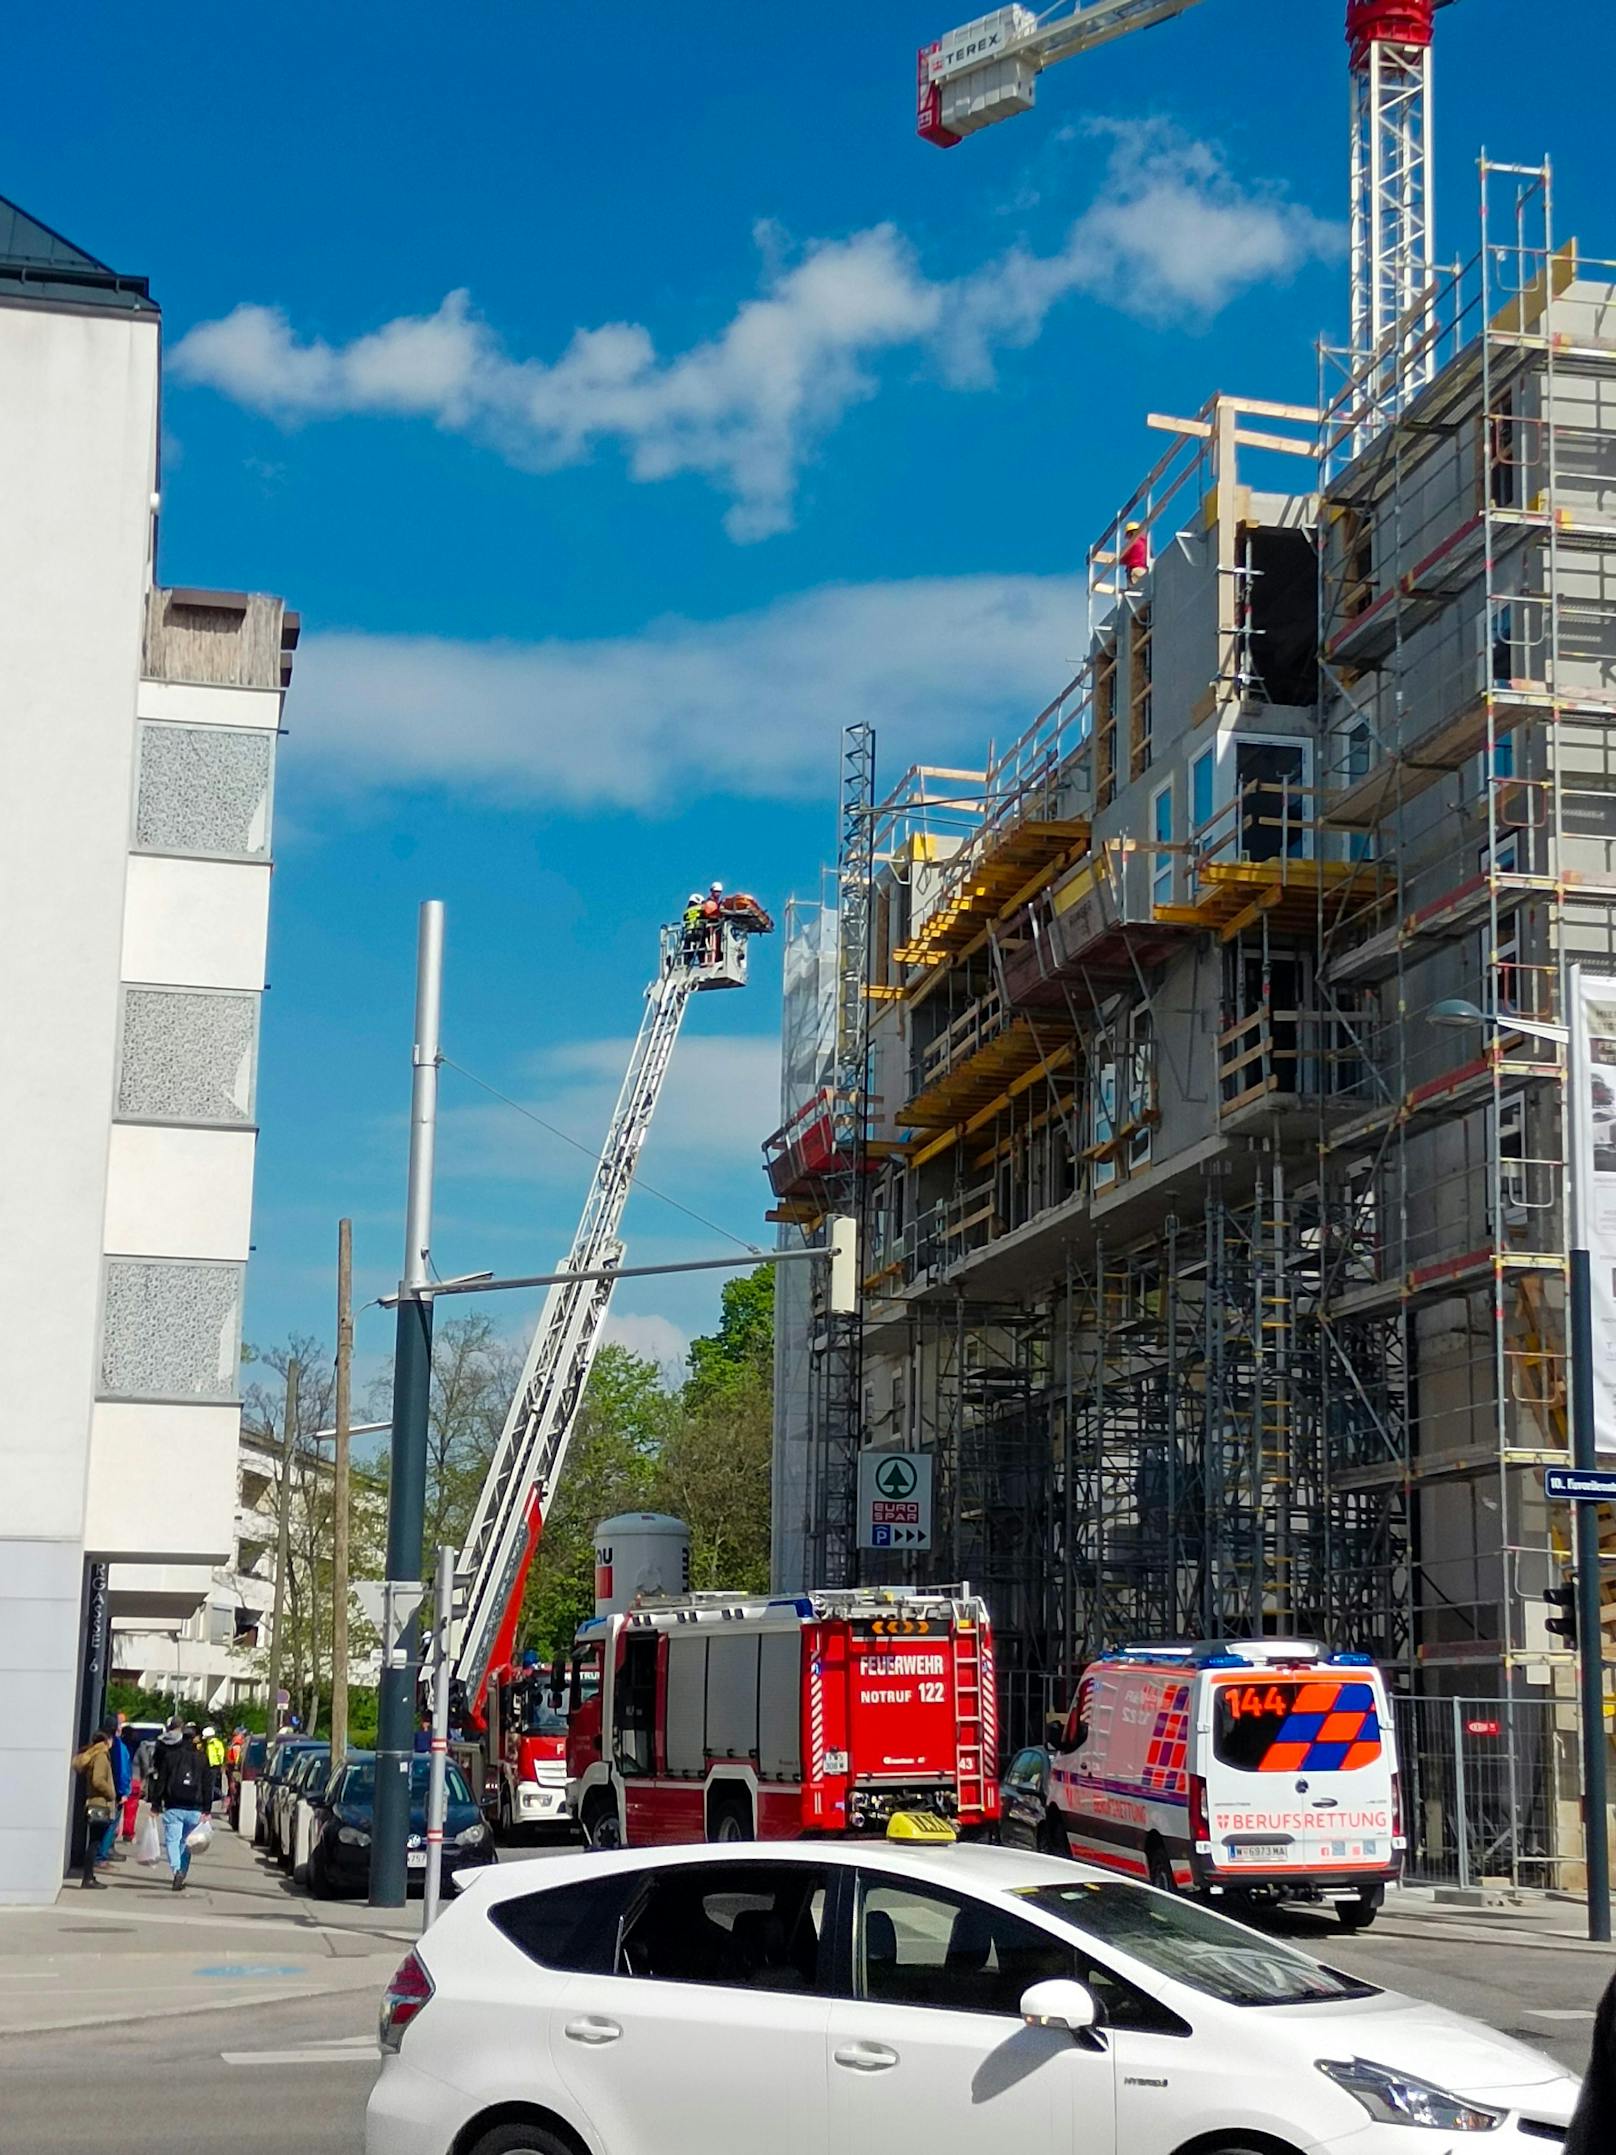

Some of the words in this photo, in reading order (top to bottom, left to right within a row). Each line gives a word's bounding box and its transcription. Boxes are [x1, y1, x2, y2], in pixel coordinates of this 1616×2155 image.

[946, 33, 999, 64] TEREX
[873, 1502, 918, 1513] EURO
[873, 1512, 918, 1522] SPAR
[860, 1654, 944, 1677] FEUERWEHR
[860, 1689, 912, 1704] NOTRUF
[917, 1682, 946, 1704] 122
[1224, 1686, 1287, 1719] 144
[958, 1757, 974, 1770] 43
[1233, 1811, 1387, 1830] BERUFSRETTUNG
